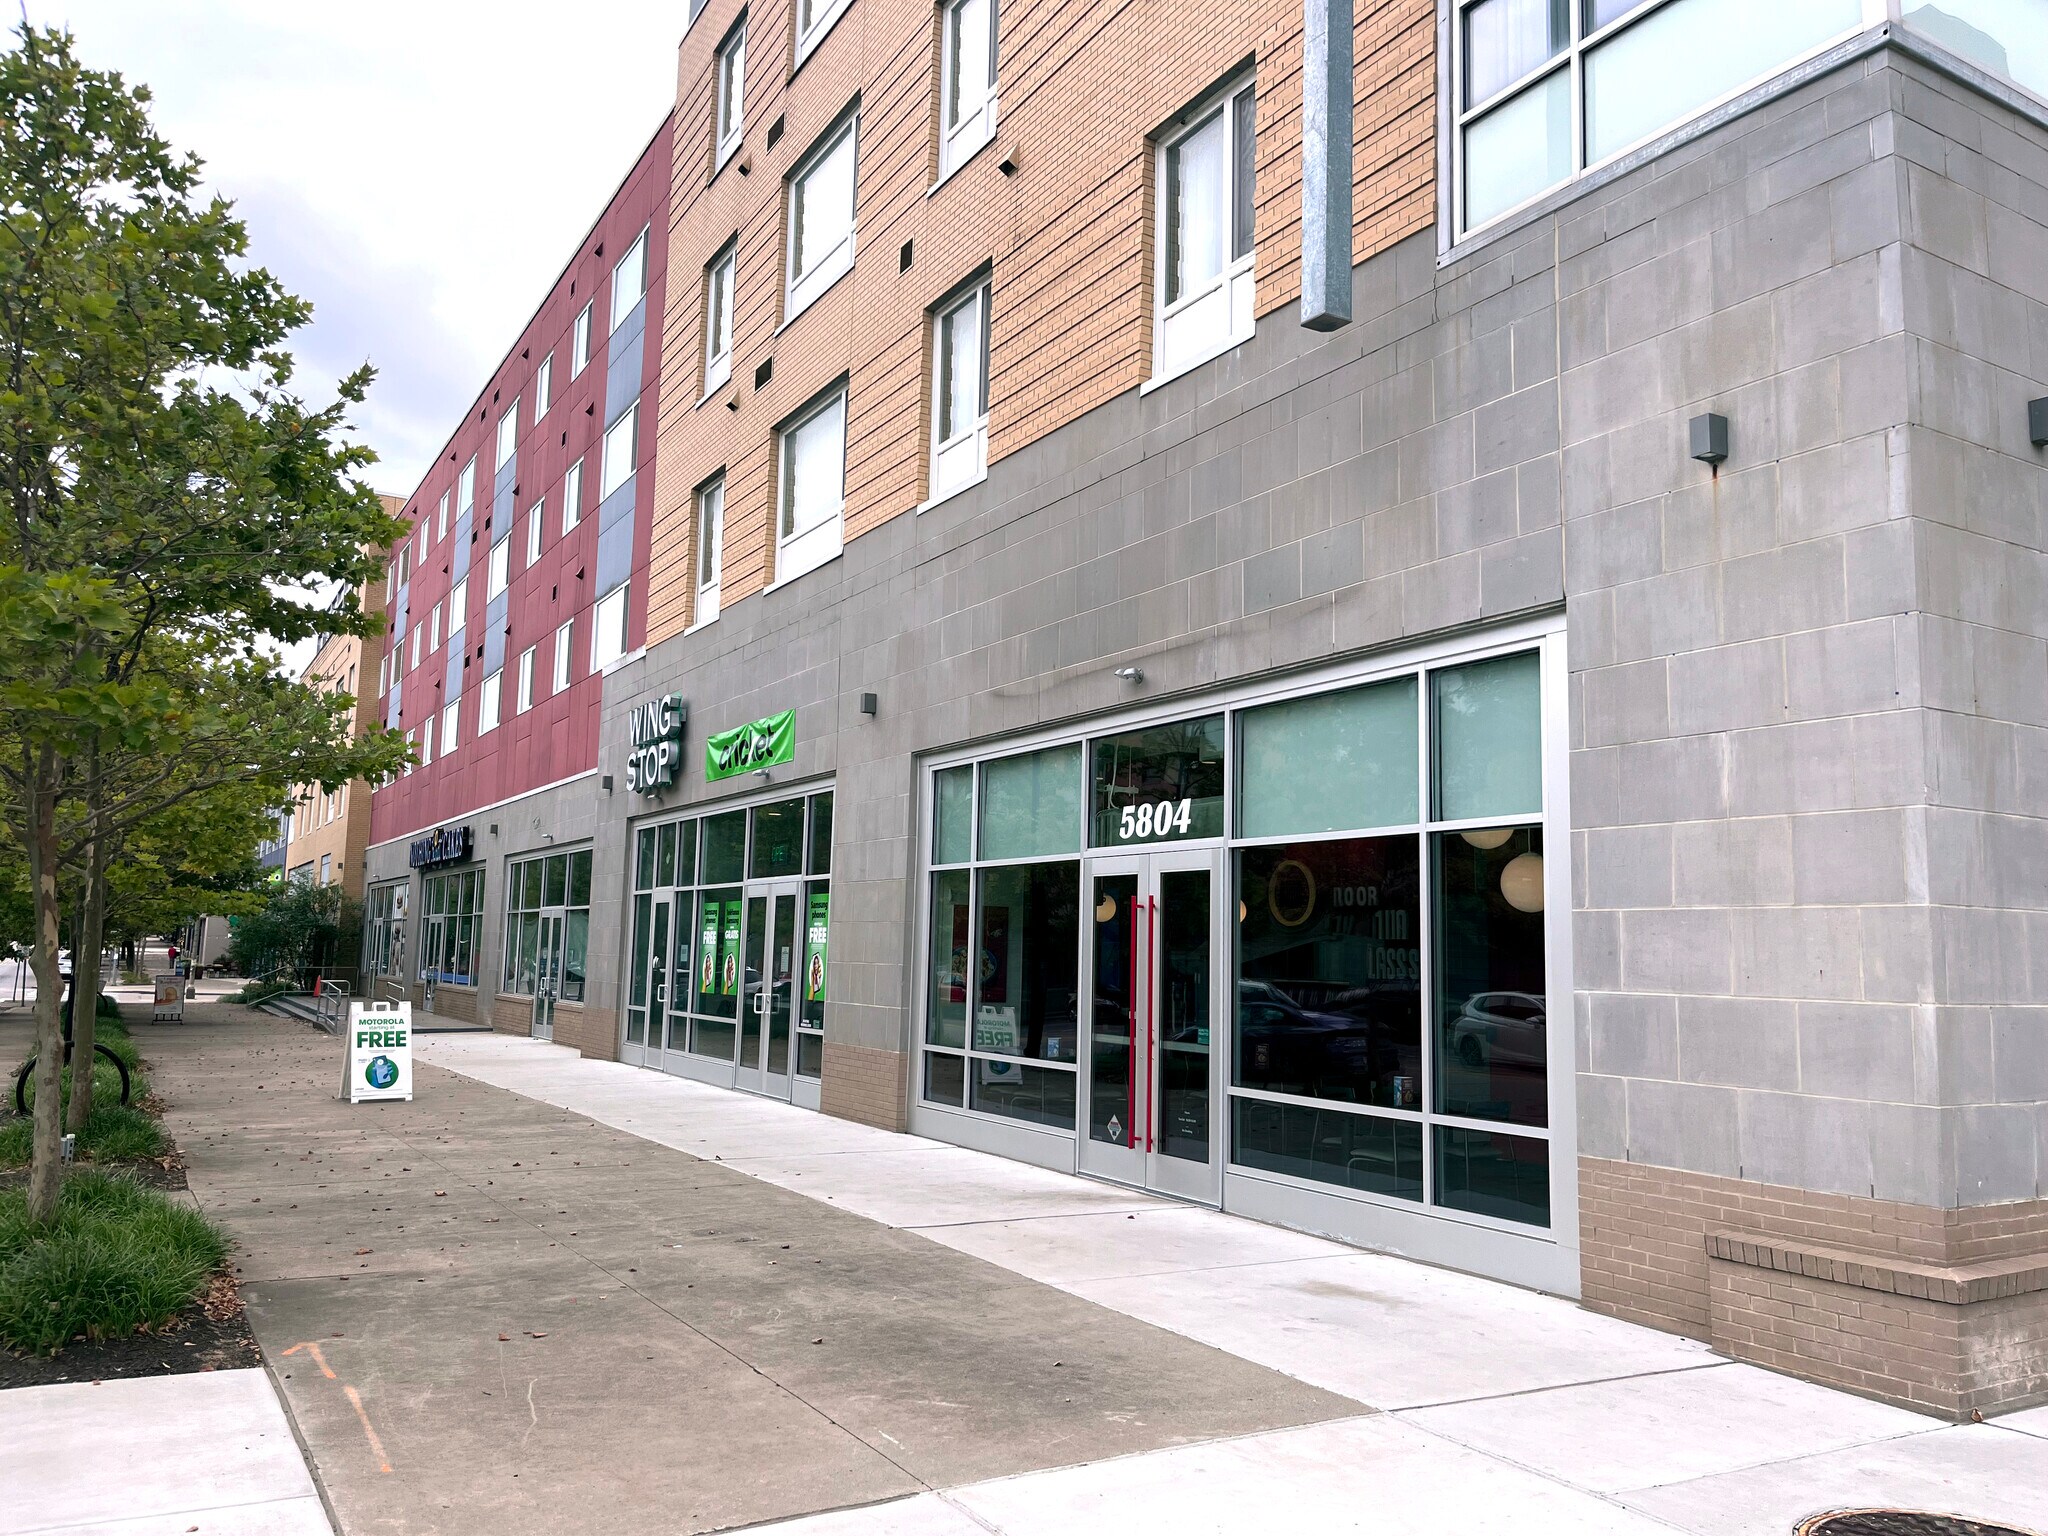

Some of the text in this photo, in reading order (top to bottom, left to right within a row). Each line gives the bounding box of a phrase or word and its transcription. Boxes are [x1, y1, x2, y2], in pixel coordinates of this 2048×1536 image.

[629, 694, 671, 746] WING
[718, 723, 776, 771] cricket
[626, 740, 669, 791] STOP
[1119, 798, 1192, 839] 5804
[811, 901, 828, 910] Samsung
[812, 911, 826, 920] phones
[703, 930, 717, 944] FREE
[809, 927, 827, 943] FREE
[357, 1030, 407, 1048] FREE
